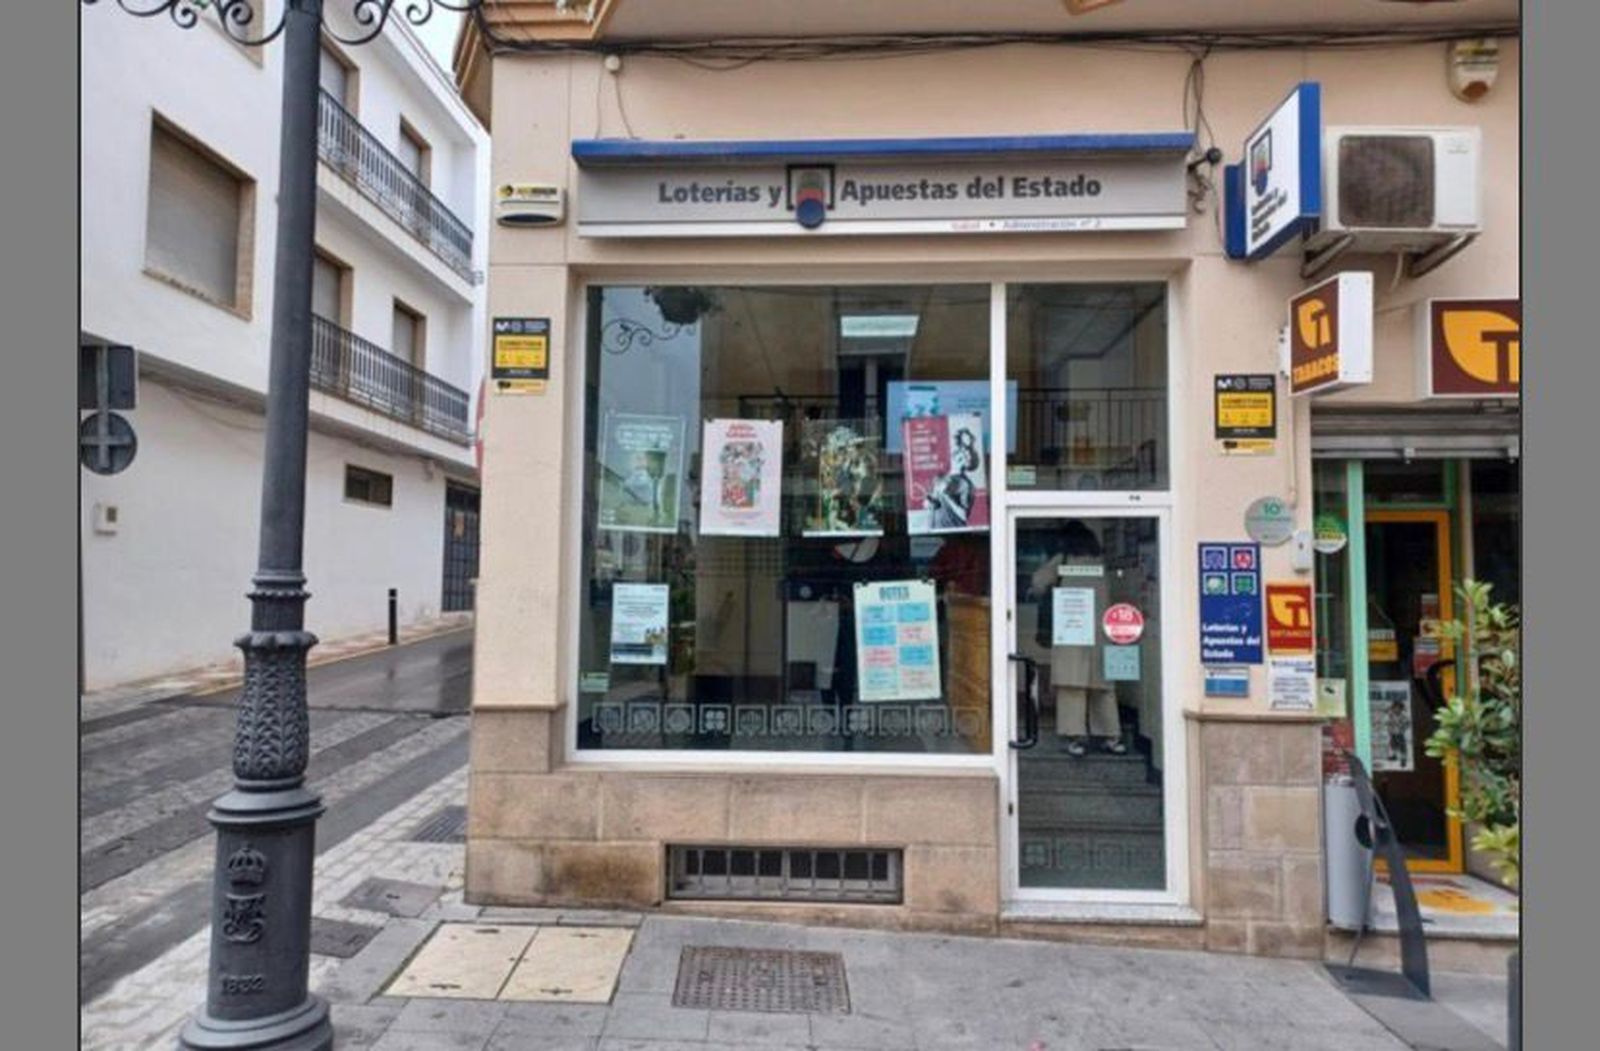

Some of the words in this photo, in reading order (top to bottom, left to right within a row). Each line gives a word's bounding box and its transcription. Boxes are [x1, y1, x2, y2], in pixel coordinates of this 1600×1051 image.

[768, 184, 783, 208] y
[840, 179, 959, 207] Apuestas
[966, 175, 1005, 200] del
[1012, 173, 1102, 199] Estado
[1292, 353, 1342, 385] TABACOS
